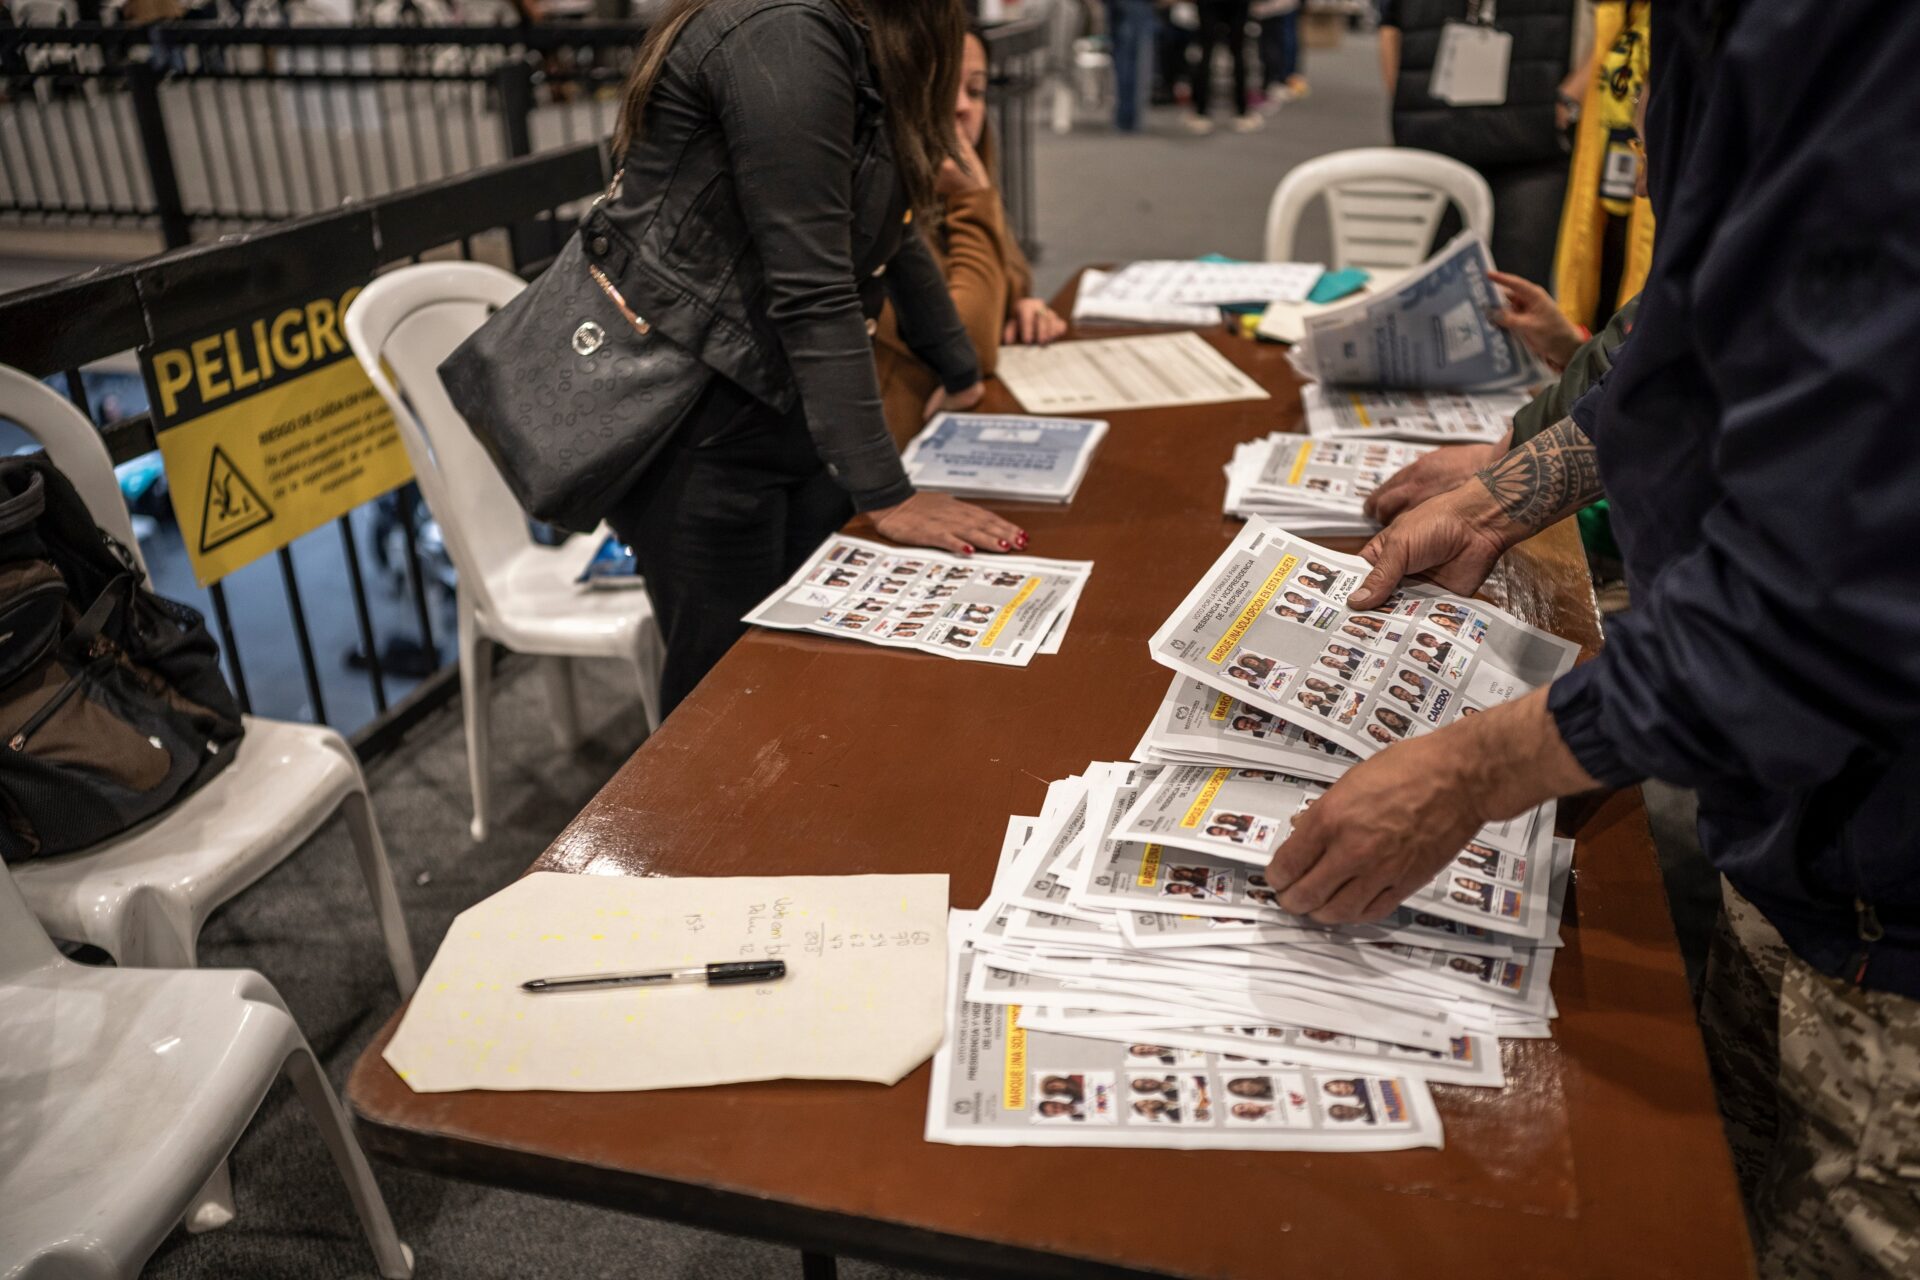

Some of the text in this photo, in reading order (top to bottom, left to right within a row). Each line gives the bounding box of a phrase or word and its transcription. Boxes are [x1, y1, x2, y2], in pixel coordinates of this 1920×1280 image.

[1192, 601, 1221, 635] PRESIDENCIA
[1220, 558, 1255, 600] VICEPRESIDENCIA
[1210, 555, 1297, 664] MARQUE UNA SOLA OPCIÓN EN ESTA TARJETA
[1215, 611, 1225, 622] DE
[1220, 604, 1231, 615] LA
[1214, 694, 1235, 720] MARQ
[1427, 690, 1451, 723] CAICEDO
[967, 1029, 979, 1080] PRESIDENCIA
[1011, 1027, 1024, 1049] SOLA
[1011, 1051, 1023, 1068] UNA
[1008, 1070, 1024, 1107] MARQUE
